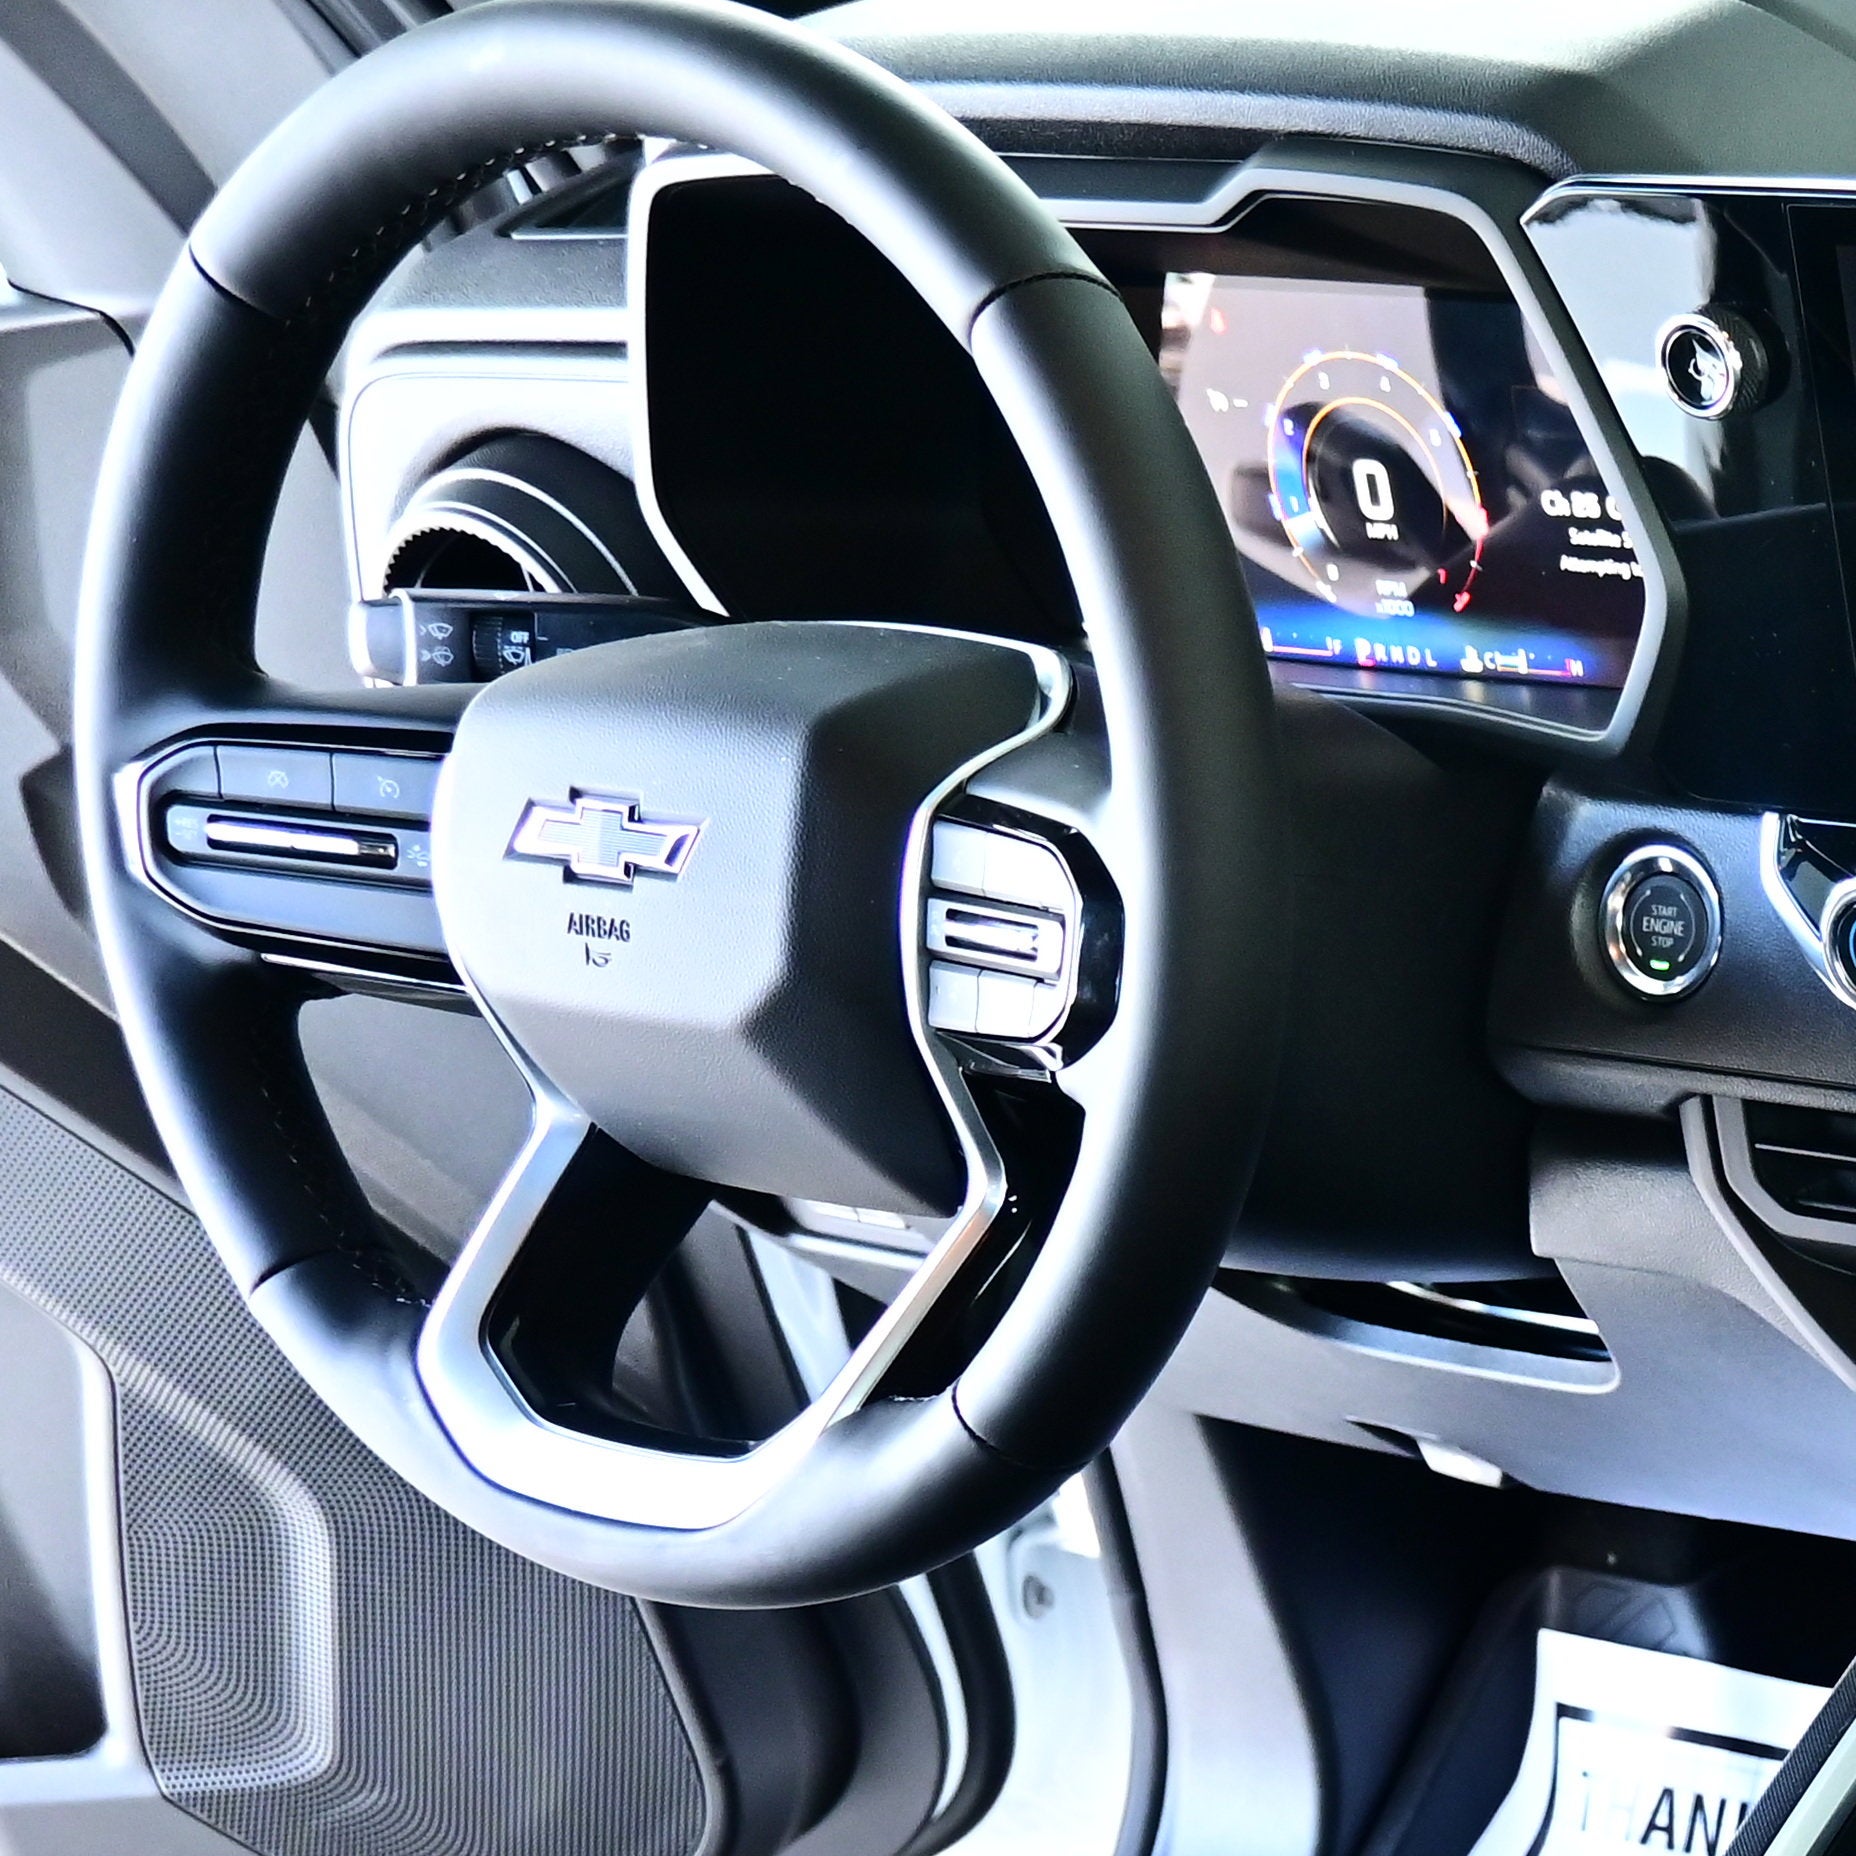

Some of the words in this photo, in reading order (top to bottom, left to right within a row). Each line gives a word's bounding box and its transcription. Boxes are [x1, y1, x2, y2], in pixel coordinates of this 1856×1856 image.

[1352, 457, 1395, 522] 0
[1651, 904, 1678, 918] START
[567, 912, 631, 943] AIRBAG
[1642, 916, 1686, 937] ENGINE
[1651, 935, 1675, 948] STOP
